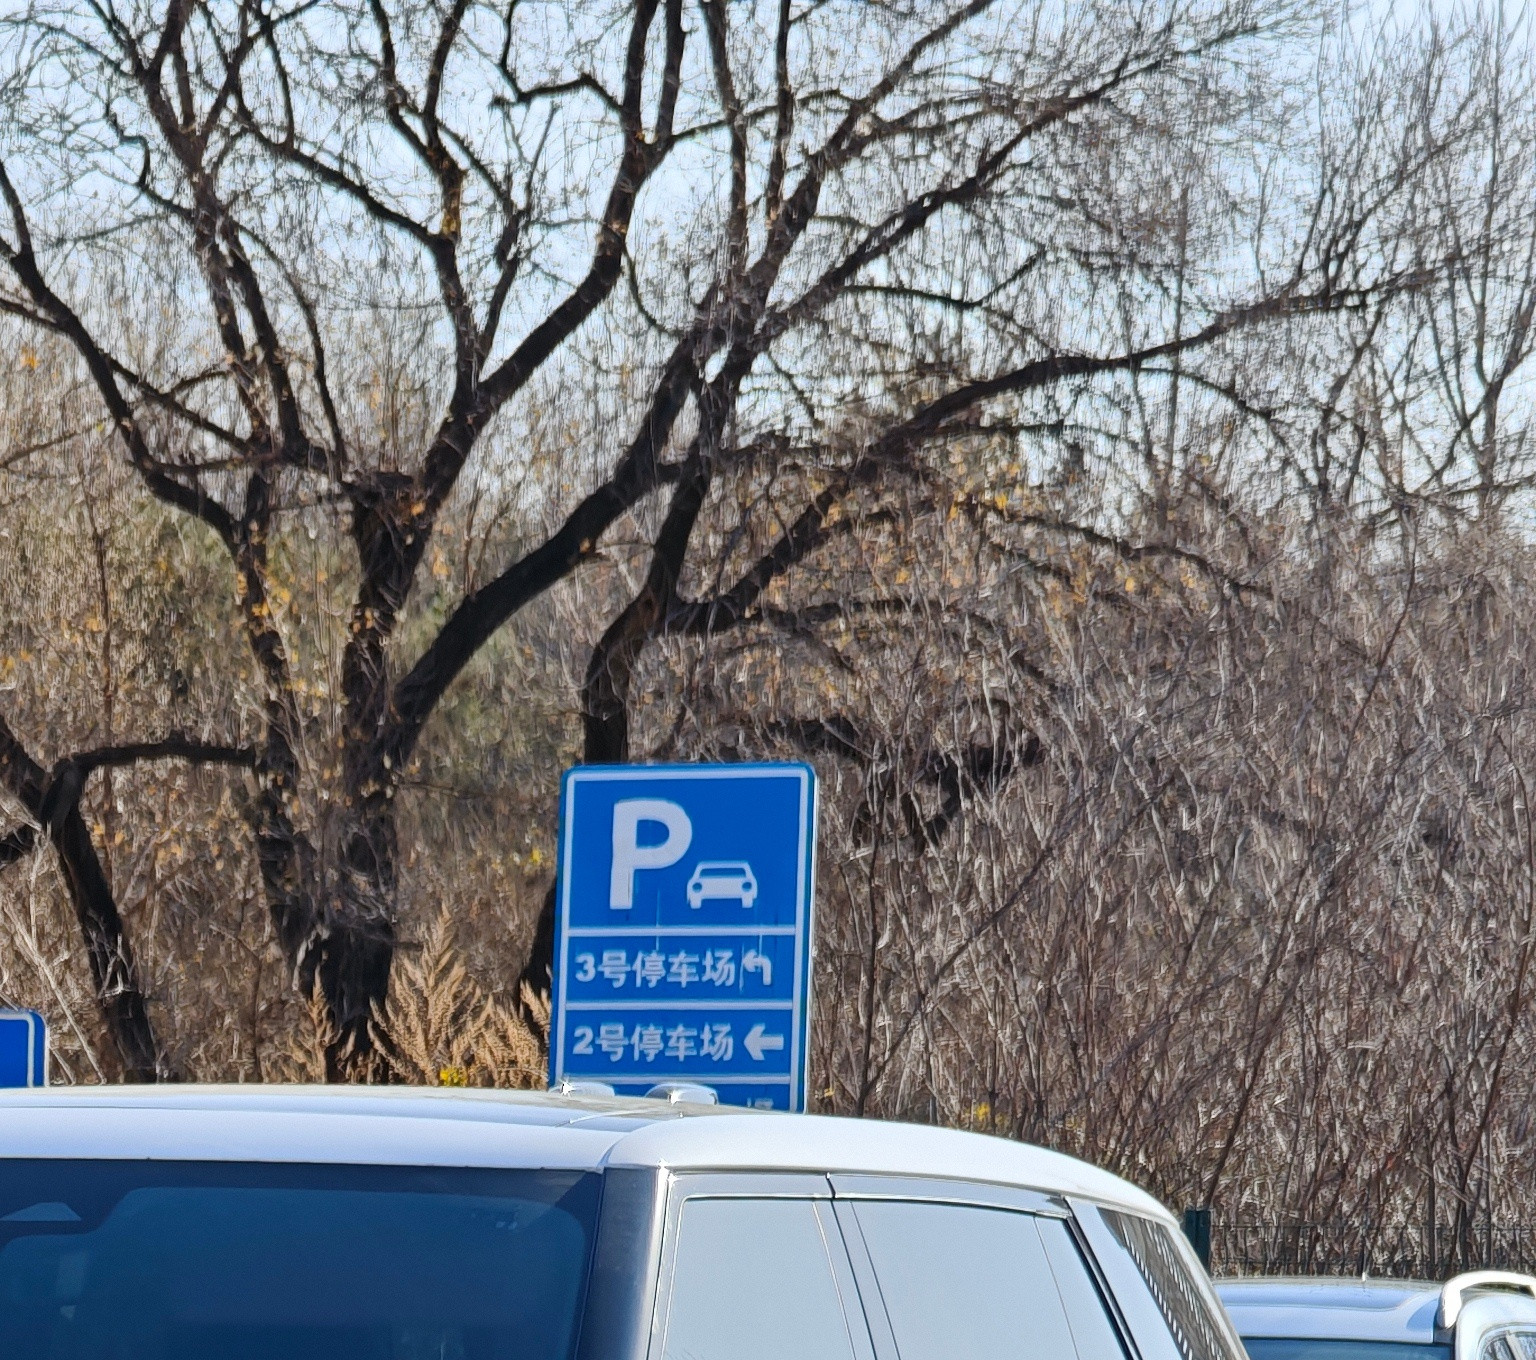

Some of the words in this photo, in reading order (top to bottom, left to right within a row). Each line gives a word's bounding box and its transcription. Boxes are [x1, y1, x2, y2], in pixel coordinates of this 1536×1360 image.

[610, 798, 693, 910] P
[575, 949, 736, 988] 3号停车场
[573, 1022, 734, 1062] 2号停车场
